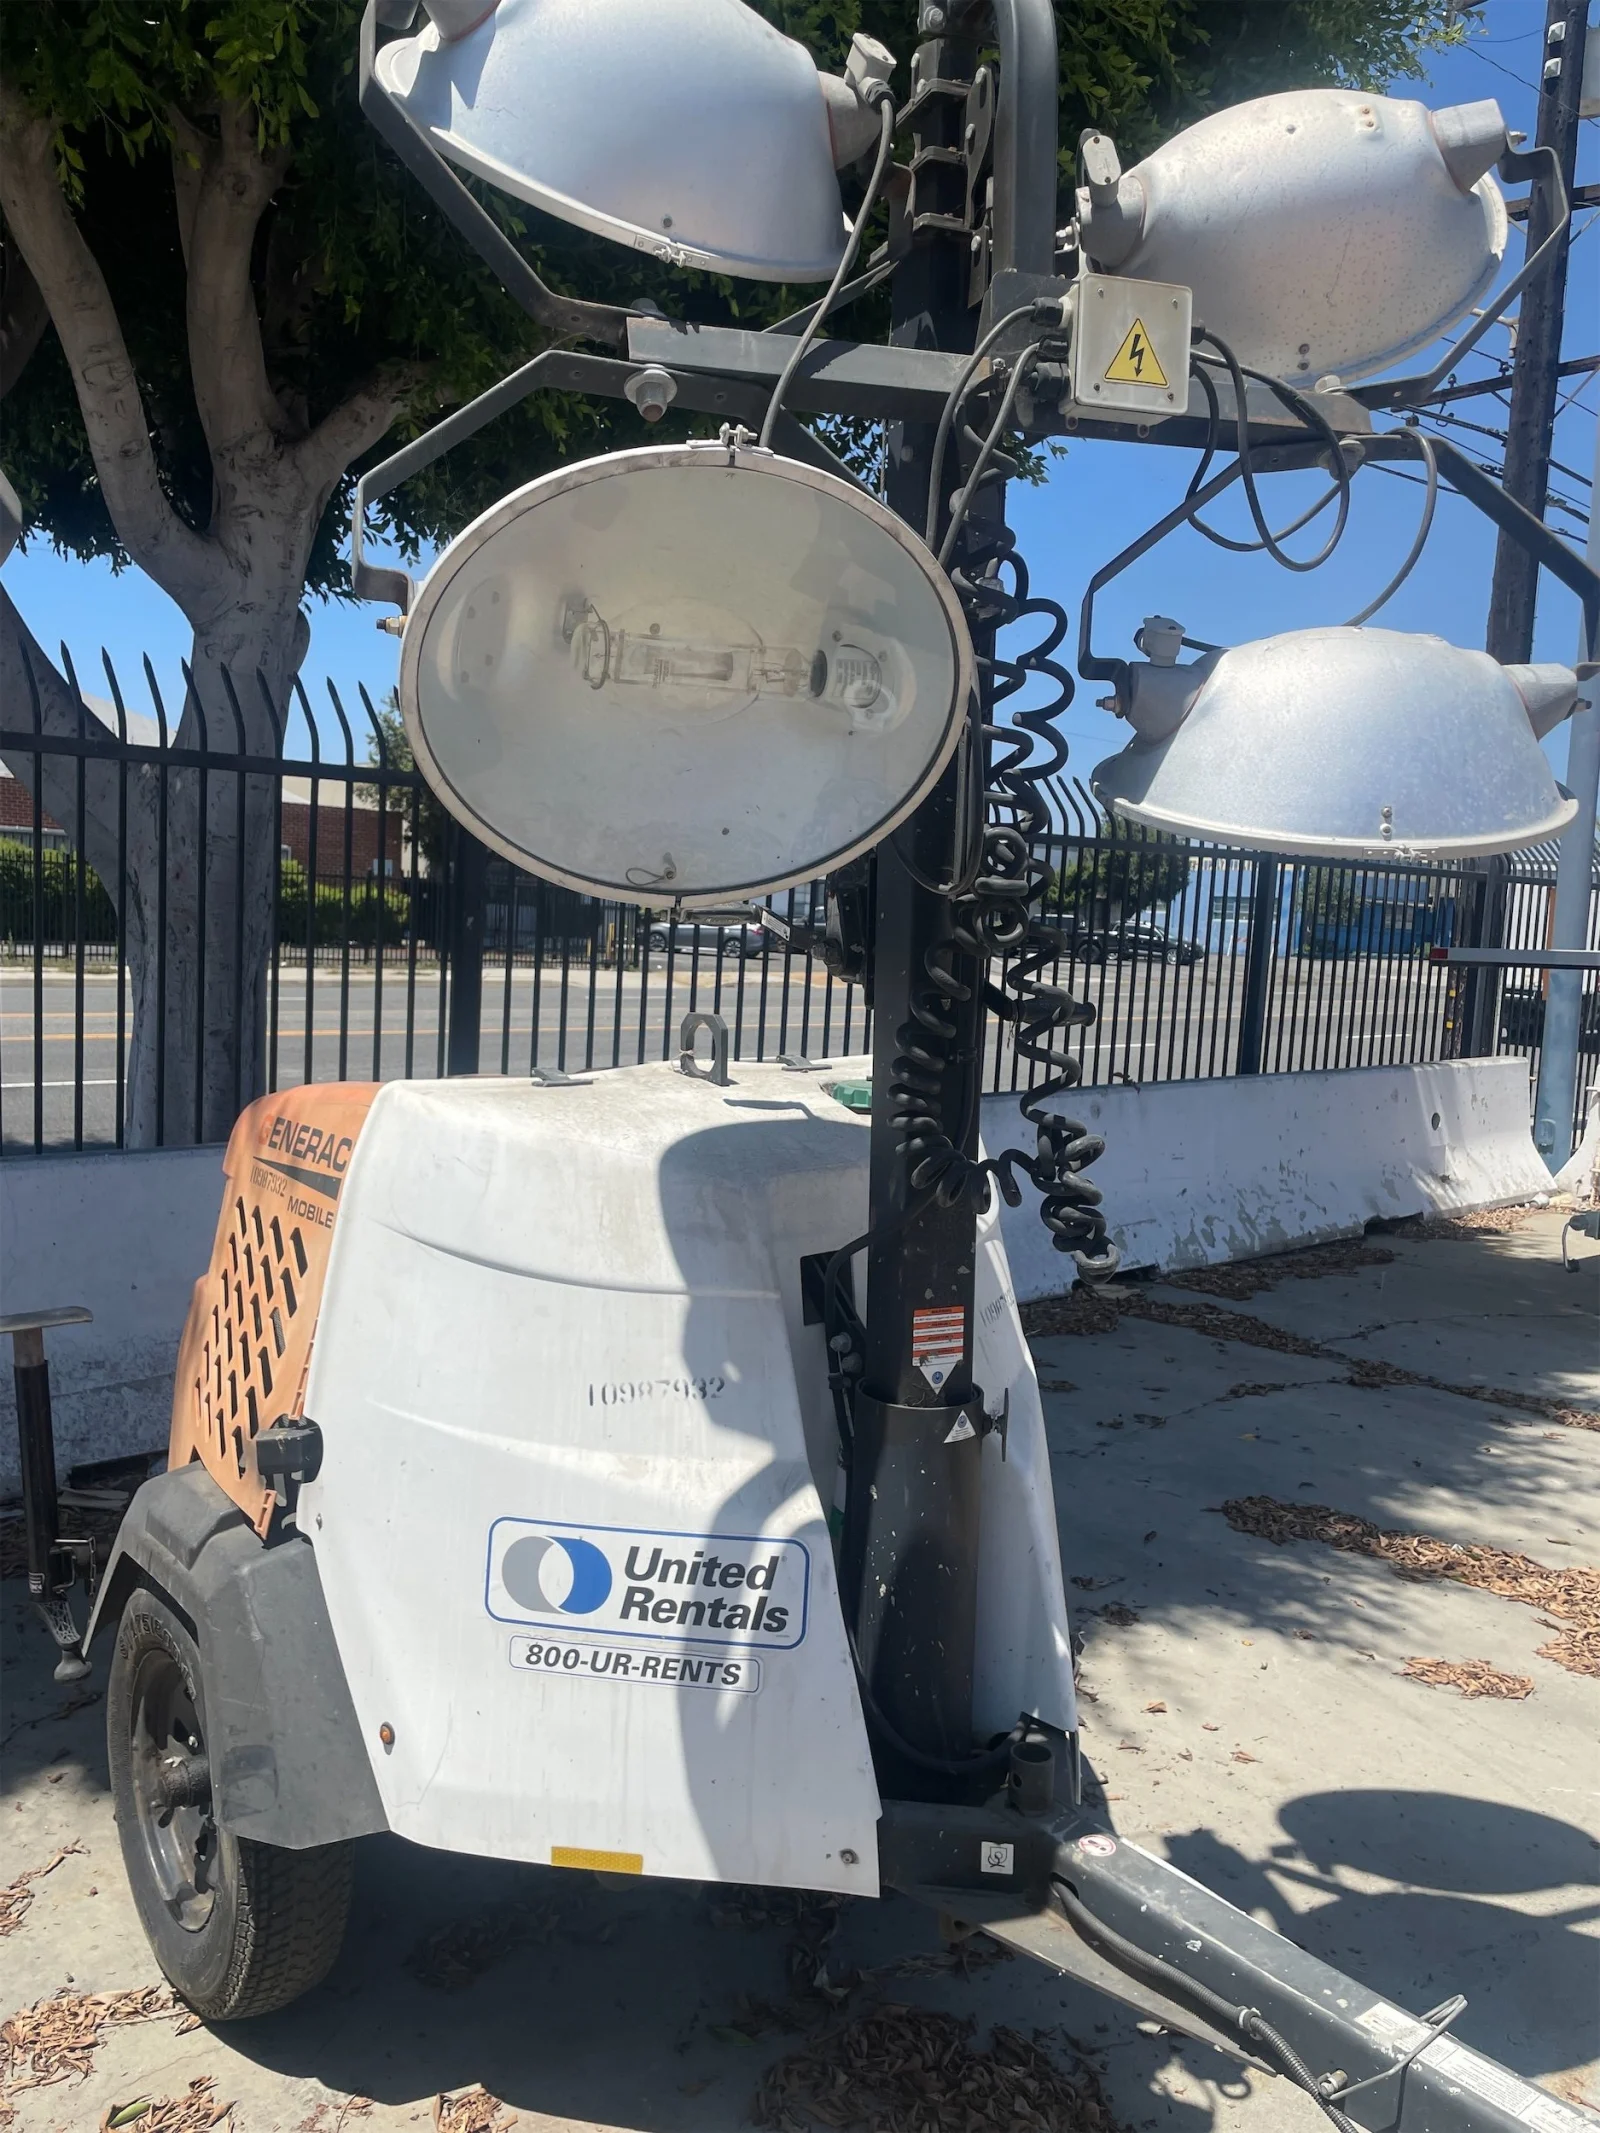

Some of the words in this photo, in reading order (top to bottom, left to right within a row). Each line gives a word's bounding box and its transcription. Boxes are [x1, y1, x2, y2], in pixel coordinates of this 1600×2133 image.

[258, 1113, 353, 1172] GENERAC
[287, 1195, 335, 1229] MOBILE
[623, 1545, 780, 1591] United
[619, 1586, 790, 1633] Rentals
[525, 1643, 742, 1686] 800-UR-RENTS
